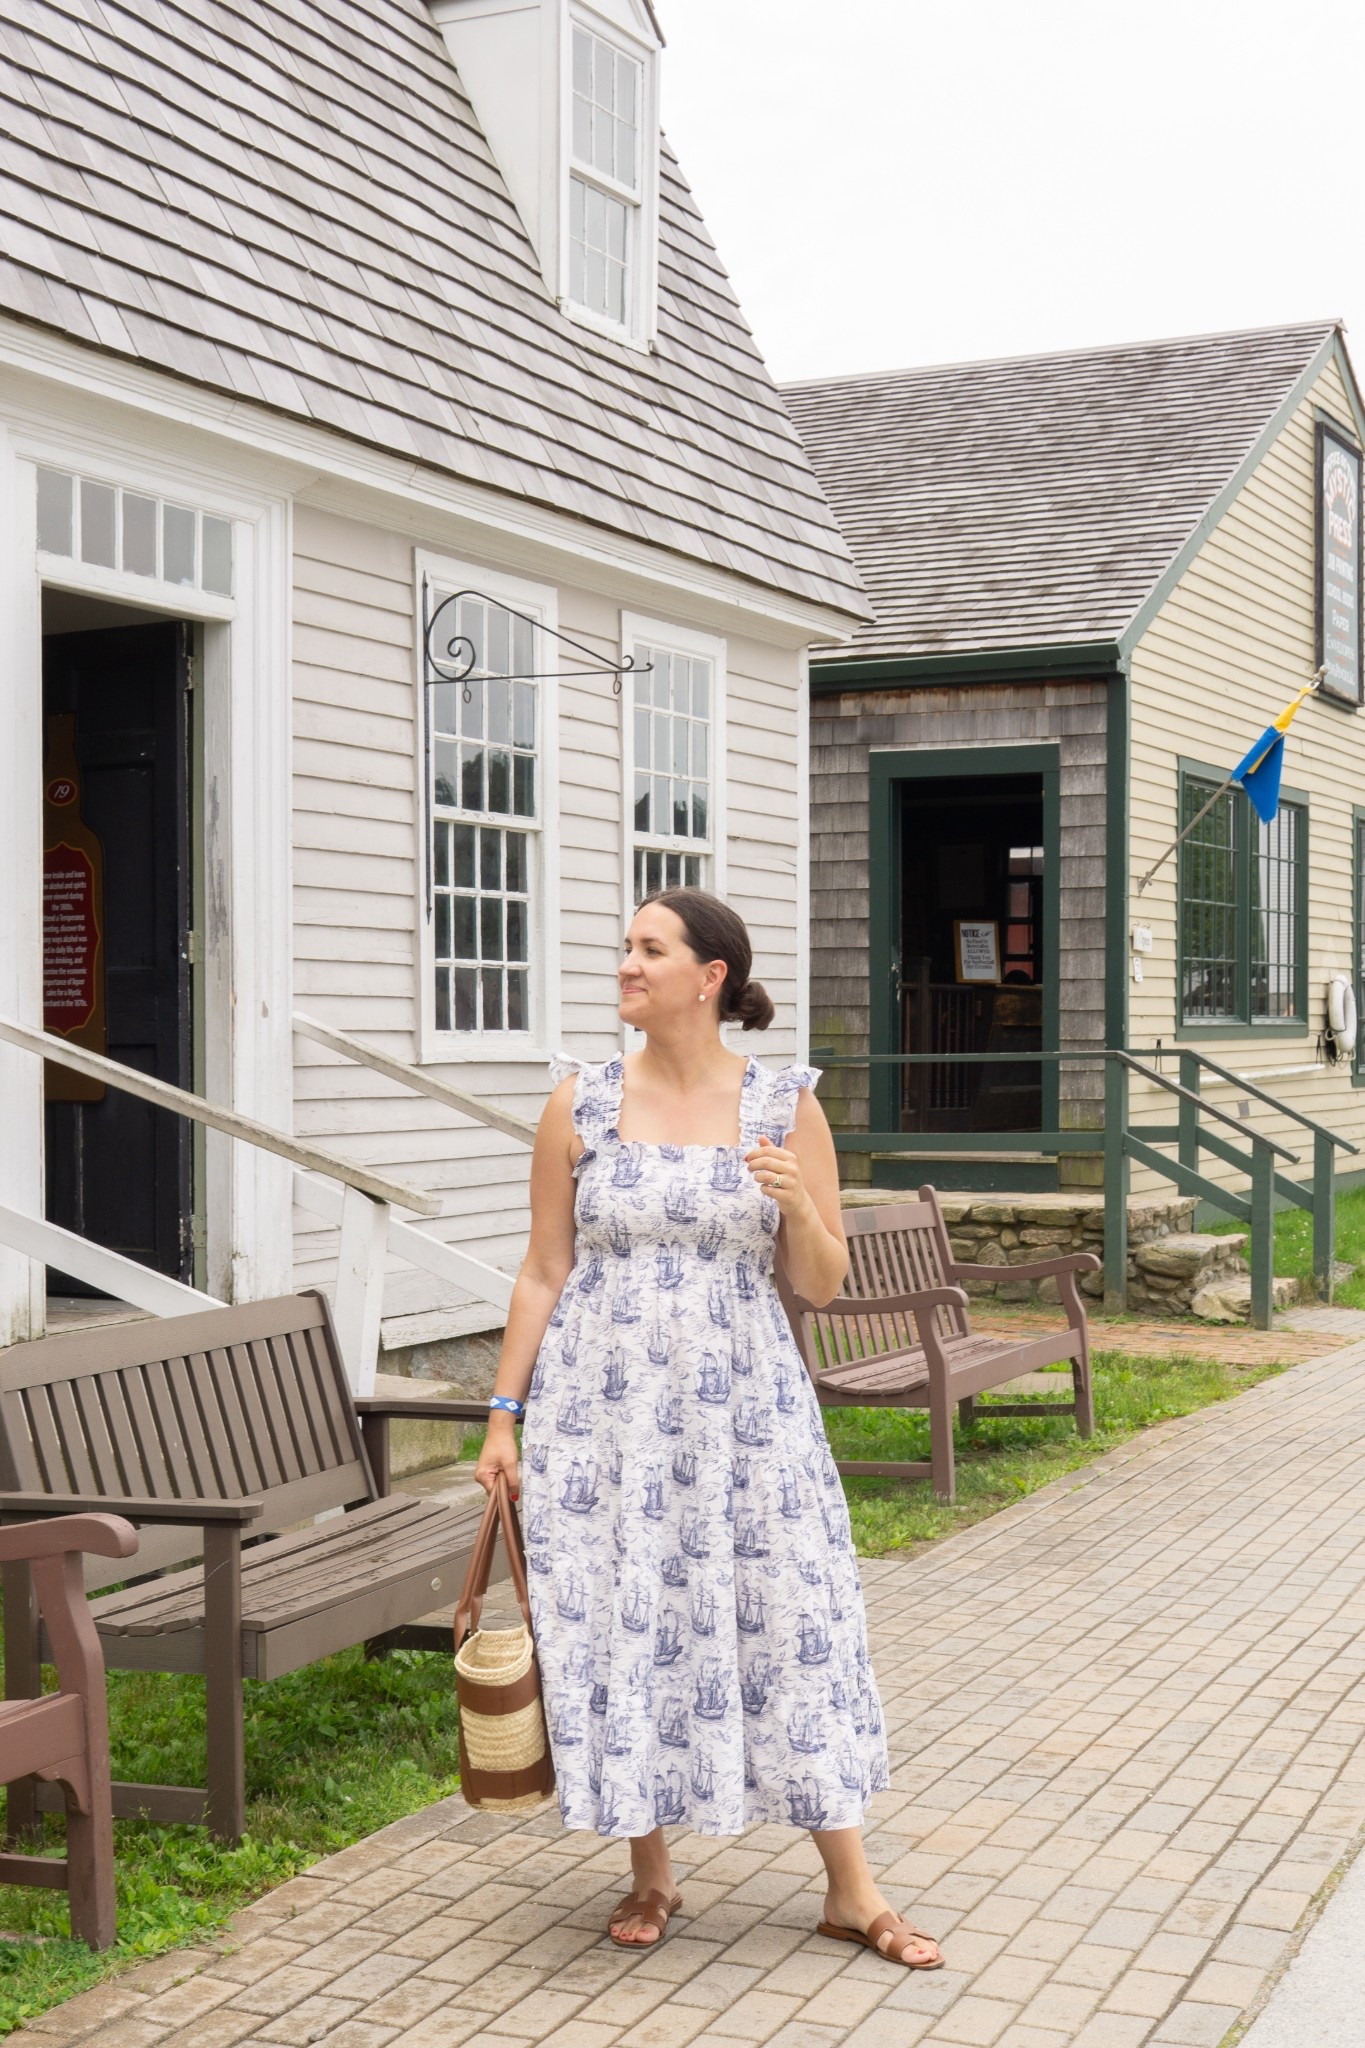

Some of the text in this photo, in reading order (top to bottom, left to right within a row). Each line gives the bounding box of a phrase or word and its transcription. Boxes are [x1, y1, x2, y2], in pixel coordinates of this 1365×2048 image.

[1325, 467, 1355, 521] MYSTIC
[1328, 510, 1352, 548] PRESS
[1332, 609, 1349, 632] PAPER
[53, 785, 70, 799] 19
[52, 871, 64, 879] inside
[49, 882, 64, 890] alcohol
[65, 881, 73, 889] and
[73, 881, 86, 890] spirits
[54, 892, 69, 900] viewed
[69, 892, 84, 901] during
[59, 913, 85, 923] Temperance
[60, 924, 77, 932] discover
[961, 929, 980, 938] NOTICE
[63, 935, 78, 943] alcohol
[55, 946, 66, 954] daily
[75, 945, 87, 953] other
[55, 957, 73, 965] drinking,
[74, 956, 83, 964] and
[58, 967, 67, 975] the
[72, 978, 85, 986] liquor
[67, 988, 82, 997] Mystic
